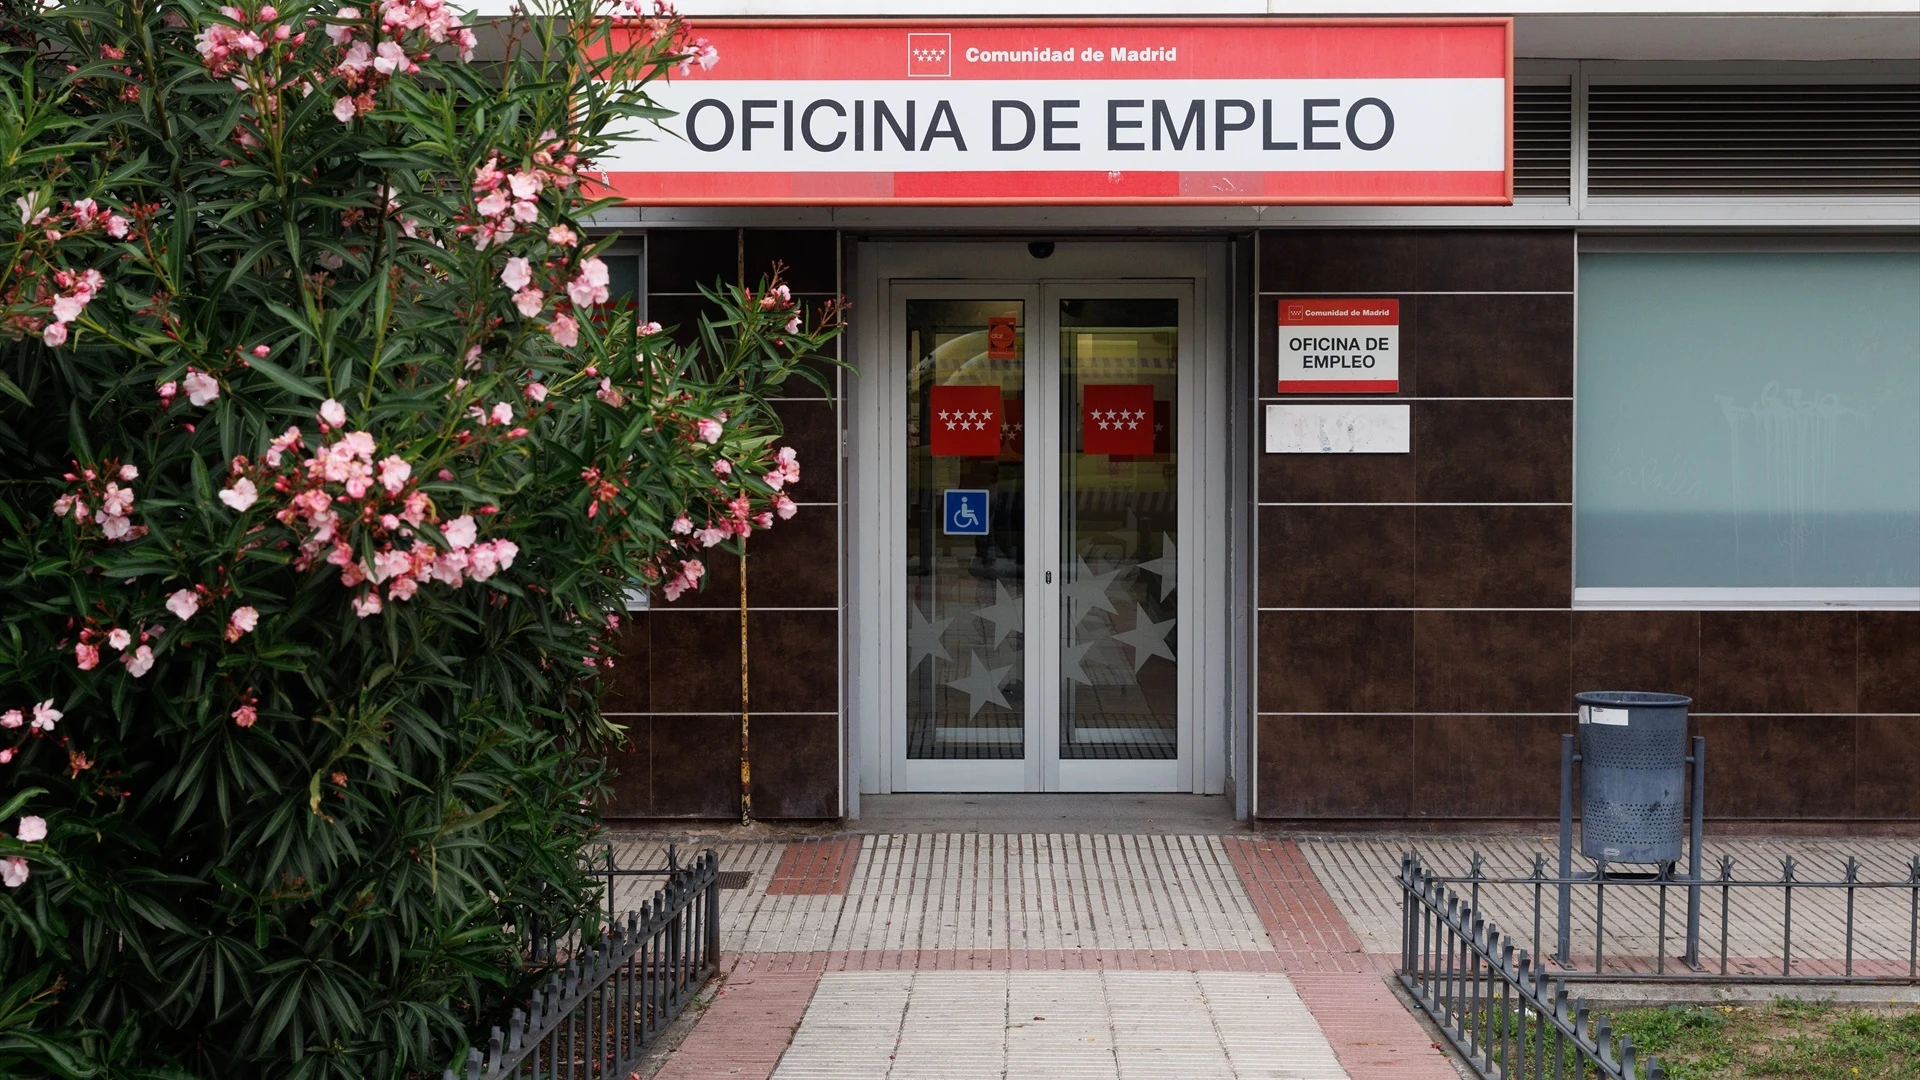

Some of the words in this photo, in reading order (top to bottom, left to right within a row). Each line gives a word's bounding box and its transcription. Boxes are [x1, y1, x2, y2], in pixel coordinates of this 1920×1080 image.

[965, 47, 1075, 63] Comunidad
[1080, 47, 1105, 63] de
[1110, 46, 1177, 63] Madrid
[685, 98, 968, 153] OFICINA
[991, 98, 1081, 152] DE
[1107, 97, 1395, 152] EMPLEO
[1305, 309, 1349, 317] Comunidad
[1350, 309, 1361, 317] de
[1362, 309, 1390, 317] Madrid
[1289, 337, 1361, 351] OFICINA
[1365, 337, 1389, 351] DE
[1302, 355, 1376, 369] EMPLEO
